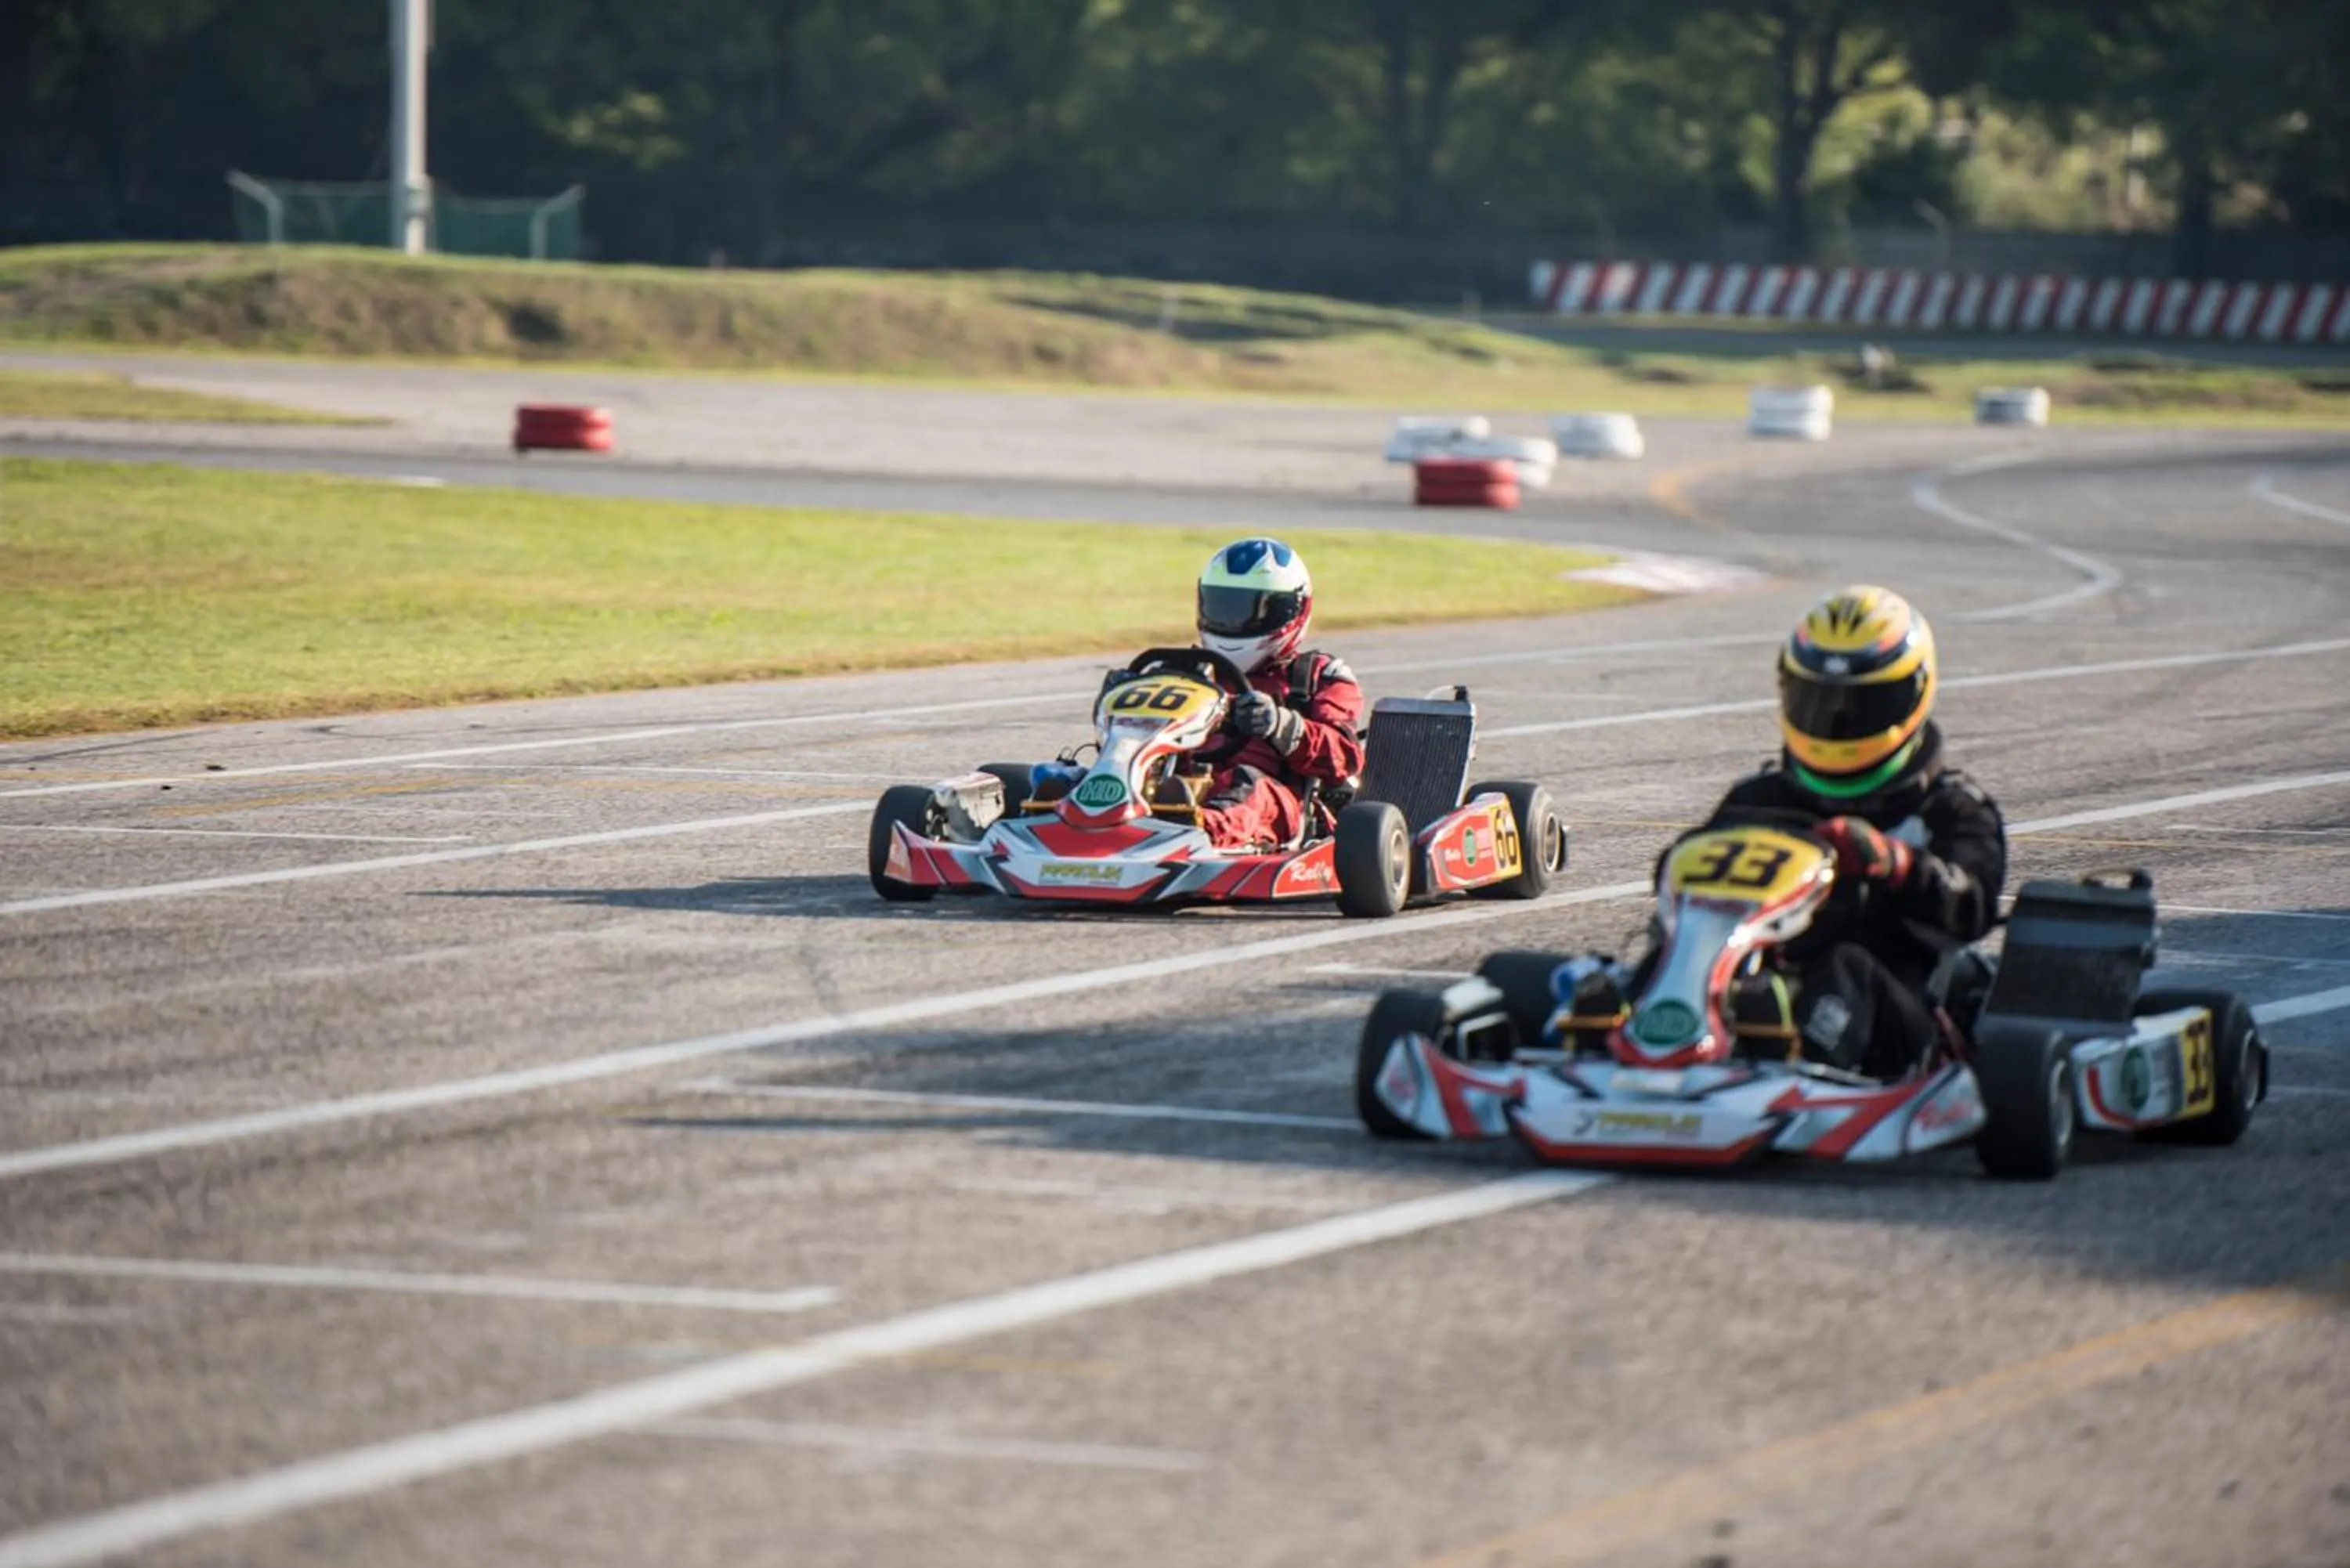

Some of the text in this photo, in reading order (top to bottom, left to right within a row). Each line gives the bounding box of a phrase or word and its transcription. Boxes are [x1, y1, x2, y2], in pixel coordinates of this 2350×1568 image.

[1113, 684, 1198, 710] 66
[1495, 808, 1517, 869] 66
[1681, 840, 1792, 887] 33
